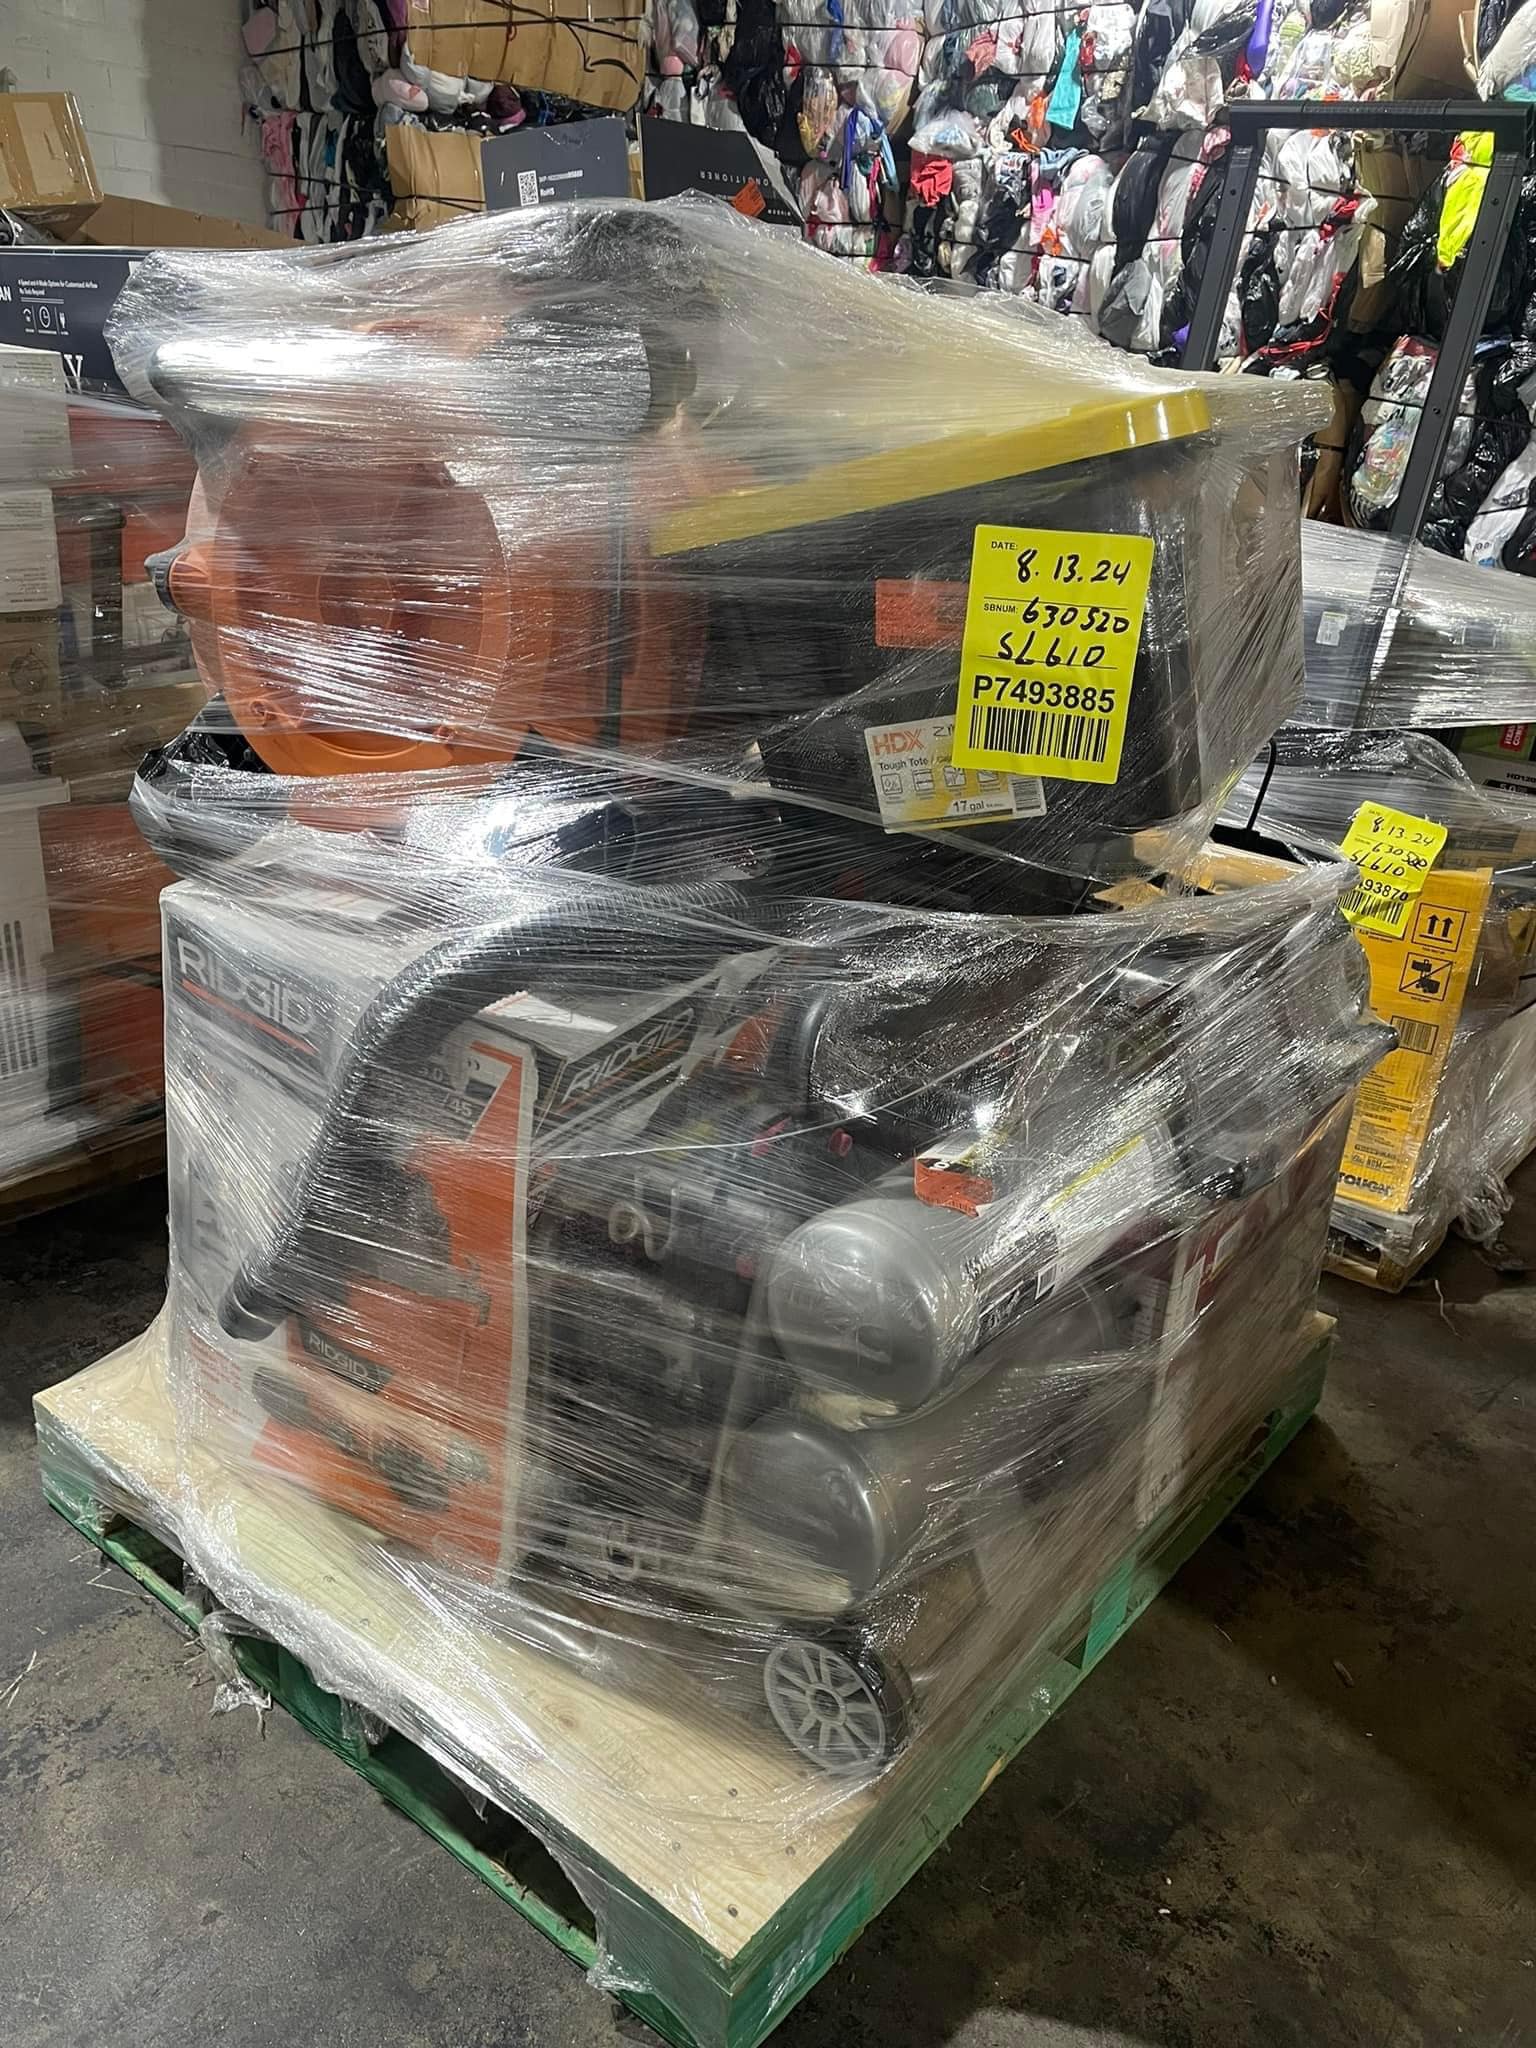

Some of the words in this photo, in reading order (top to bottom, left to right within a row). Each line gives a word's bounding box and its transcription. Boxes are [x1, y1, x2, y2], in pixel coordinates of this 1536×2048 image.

[991, 541, 1018, 551] DATE:
[983, 603, 1018, 614] SBNUM:
[973, 675, 1115, 713] P7493885
[872, 728, 924, 756] HDX
[879, 759, 907, 771] Tough
[953, 800, 967, 812] 17
[177, 937, 318, 1035] RIDGID
[309, 1330, 368, 1378] RIDGID
